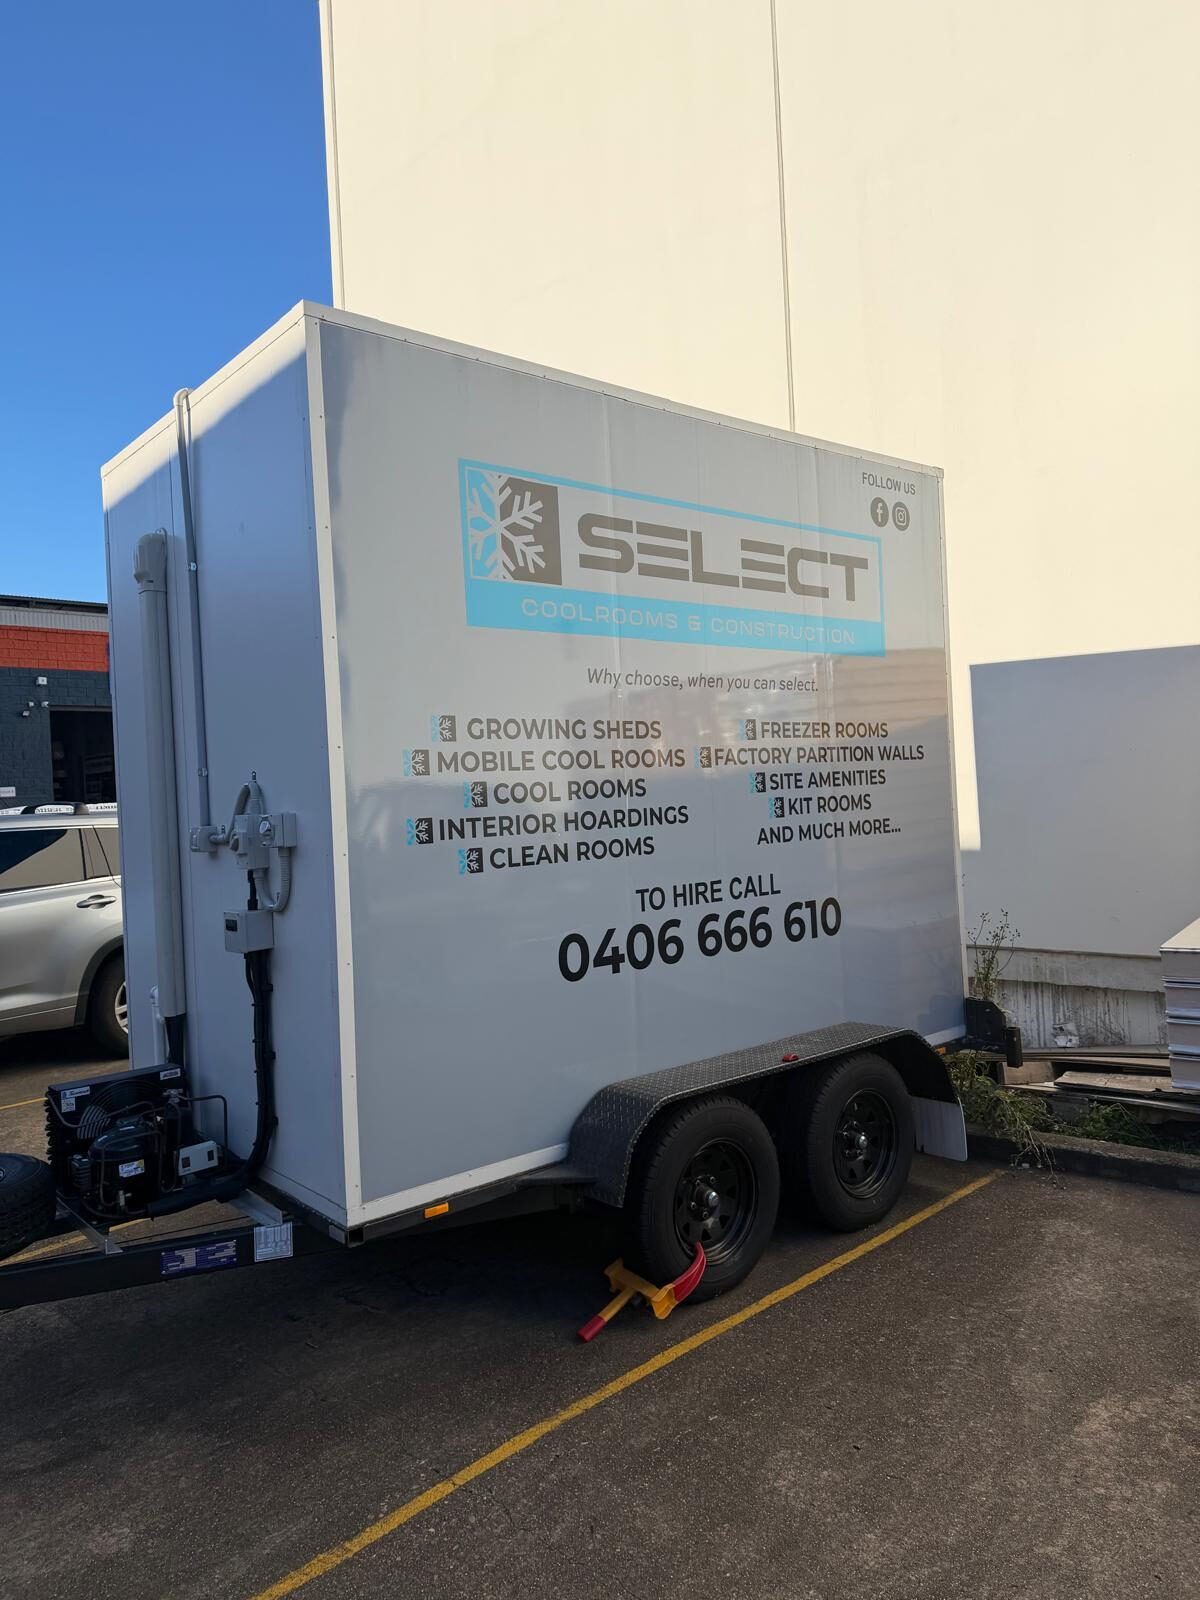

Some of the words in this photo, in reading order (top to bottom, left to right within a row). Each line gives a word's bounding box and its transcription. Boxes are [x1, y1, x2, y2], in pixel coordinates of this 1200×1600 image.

[862, 472, 901, 492] FOLLOW
[904, 482, 916, 495] US
[578, 513, 869, 602] SELECT
[521, 599, 678, 630] COOLROOMS
[688, 615, 701, 630] &
[711, 618, 855, 644] CONSTRUCTION
[587, 668, 620, 688] Why
[625, 669, 683, 690] choose,
[688, 673, 723, 688] when
[727, 680, 750, 692] you
[754, 680, 776, 691] can
[779, 676, 818, 692] select.
[467, 718, 587, 739] GROWING
[593, 720, 662, 739] SHEDS
[761, 722, 830, 739] FREEZER
[836, 722, 888, 738] ROOMS
[437, 751, 535, 773] MOBILE
[542, 750, 605, 771] COOL
[611, 749, 685, 769] ROOMS
[715, 747, 792, 765] FACTORY
[797, 746, 874, 763] PARTITION
[878, 745, 924, 761] WALLS
[493, 781, 561, 805] COOL
[567, 778, 646, 801] ROOMS
[770, 773, 803, 790] SITE
[808, 769, 886, 788] AMENITIES
[788, 797, 812, 815] KIT
[817, 793, 872, 813] ROOMS
[439, 813, 556, 841] INTERIOR
[564, 805, 688, 832] HOARDINGS
[757, 825, 793, 845] AND
[799, 822, 844, 841] MUCH
[850, 818, 901, 837] MORE...
[489, 842, 569, 869] CLEAN
[577, 836, 655, 861] ROOMS
[636, 886, 665, 912] TO
[673, 880, 723, 907] HIRE
[729, 873, 781, 900] CALL
[558, 918, 684, 982] 0406
[697, 906, 772, 957] 666
[784, 896, 842, 942] 610
